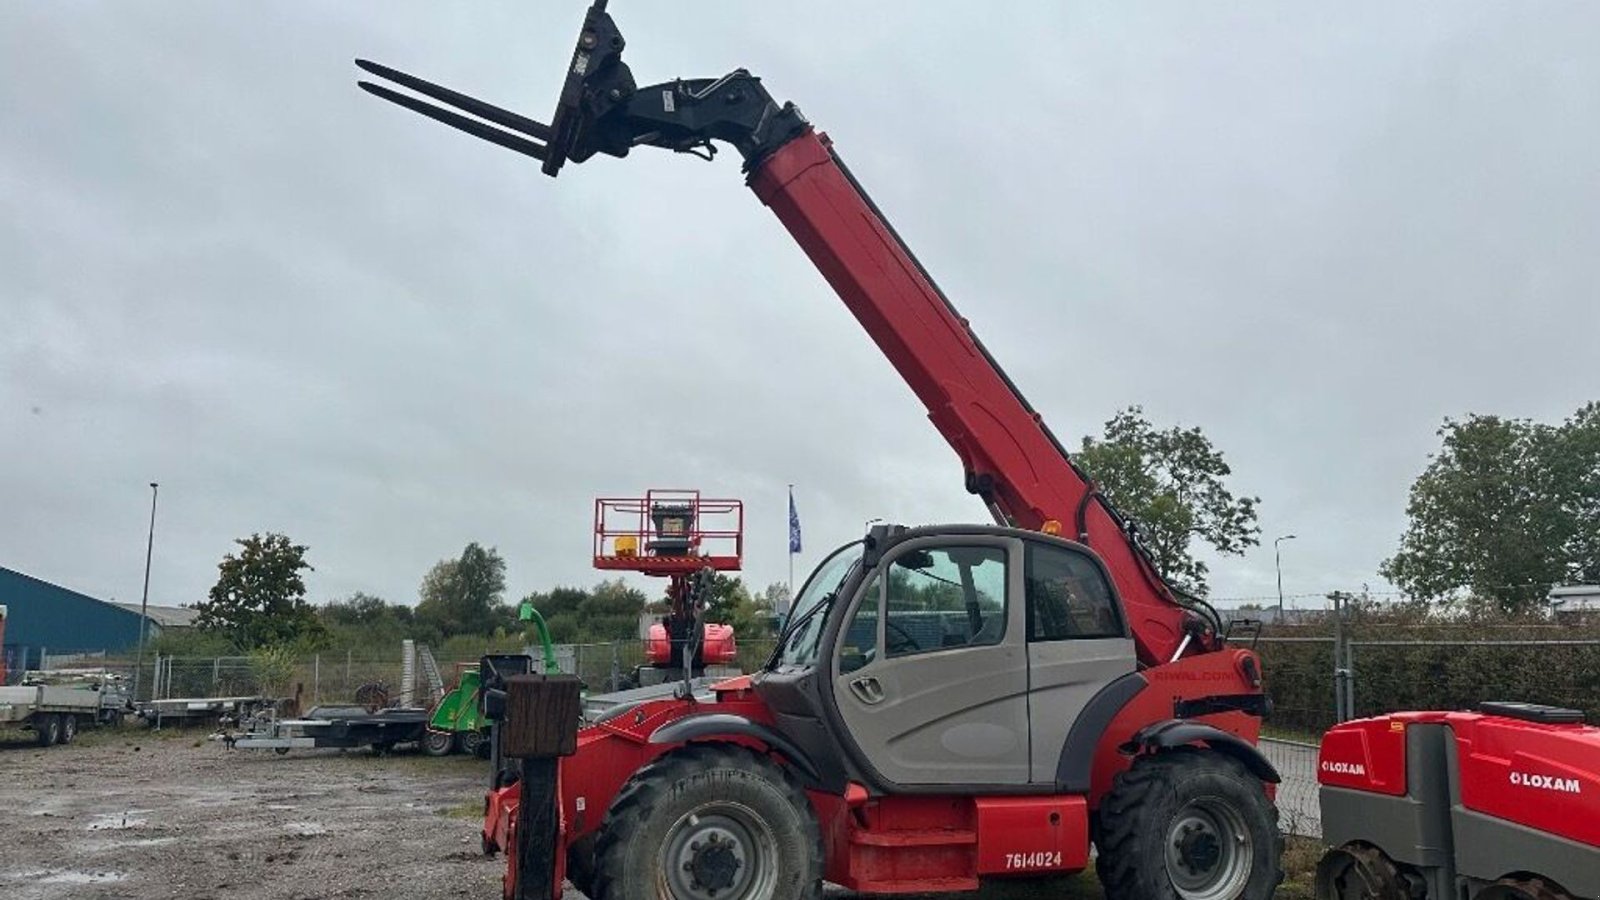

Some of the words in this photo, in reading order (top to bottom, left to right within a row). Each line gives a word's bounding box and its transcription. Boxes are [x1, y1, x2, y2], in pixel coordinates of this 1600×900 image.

[1329, 761, 1366, 776] LOXAM
[1522, 773, 1581, 794] LOXAM
[1005, 851, 1062, 869] 7614024
